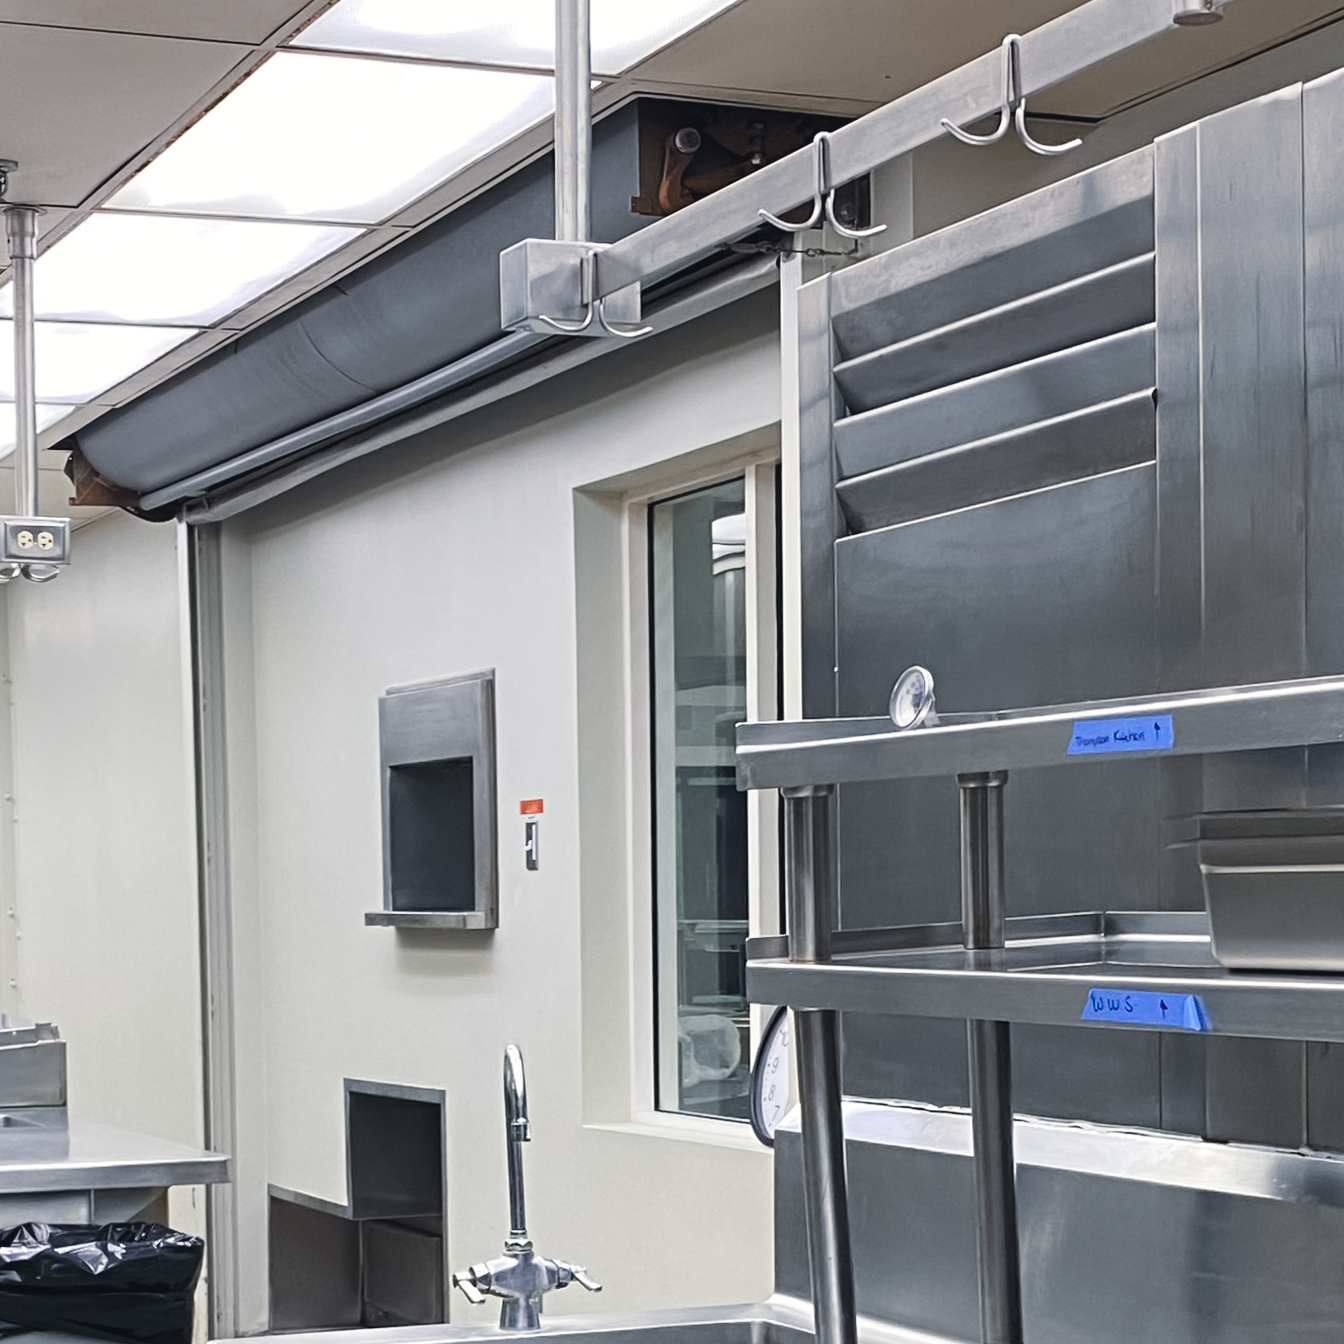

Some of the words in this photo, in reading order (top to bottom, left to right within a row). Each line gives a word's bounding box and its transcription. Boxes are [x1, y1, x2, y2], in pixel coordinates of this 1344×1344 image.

[771, 1057, 779, 1074] 9
[768, 1084, 775, 1101] 8
[773, 1105, 780, 1121] 7
